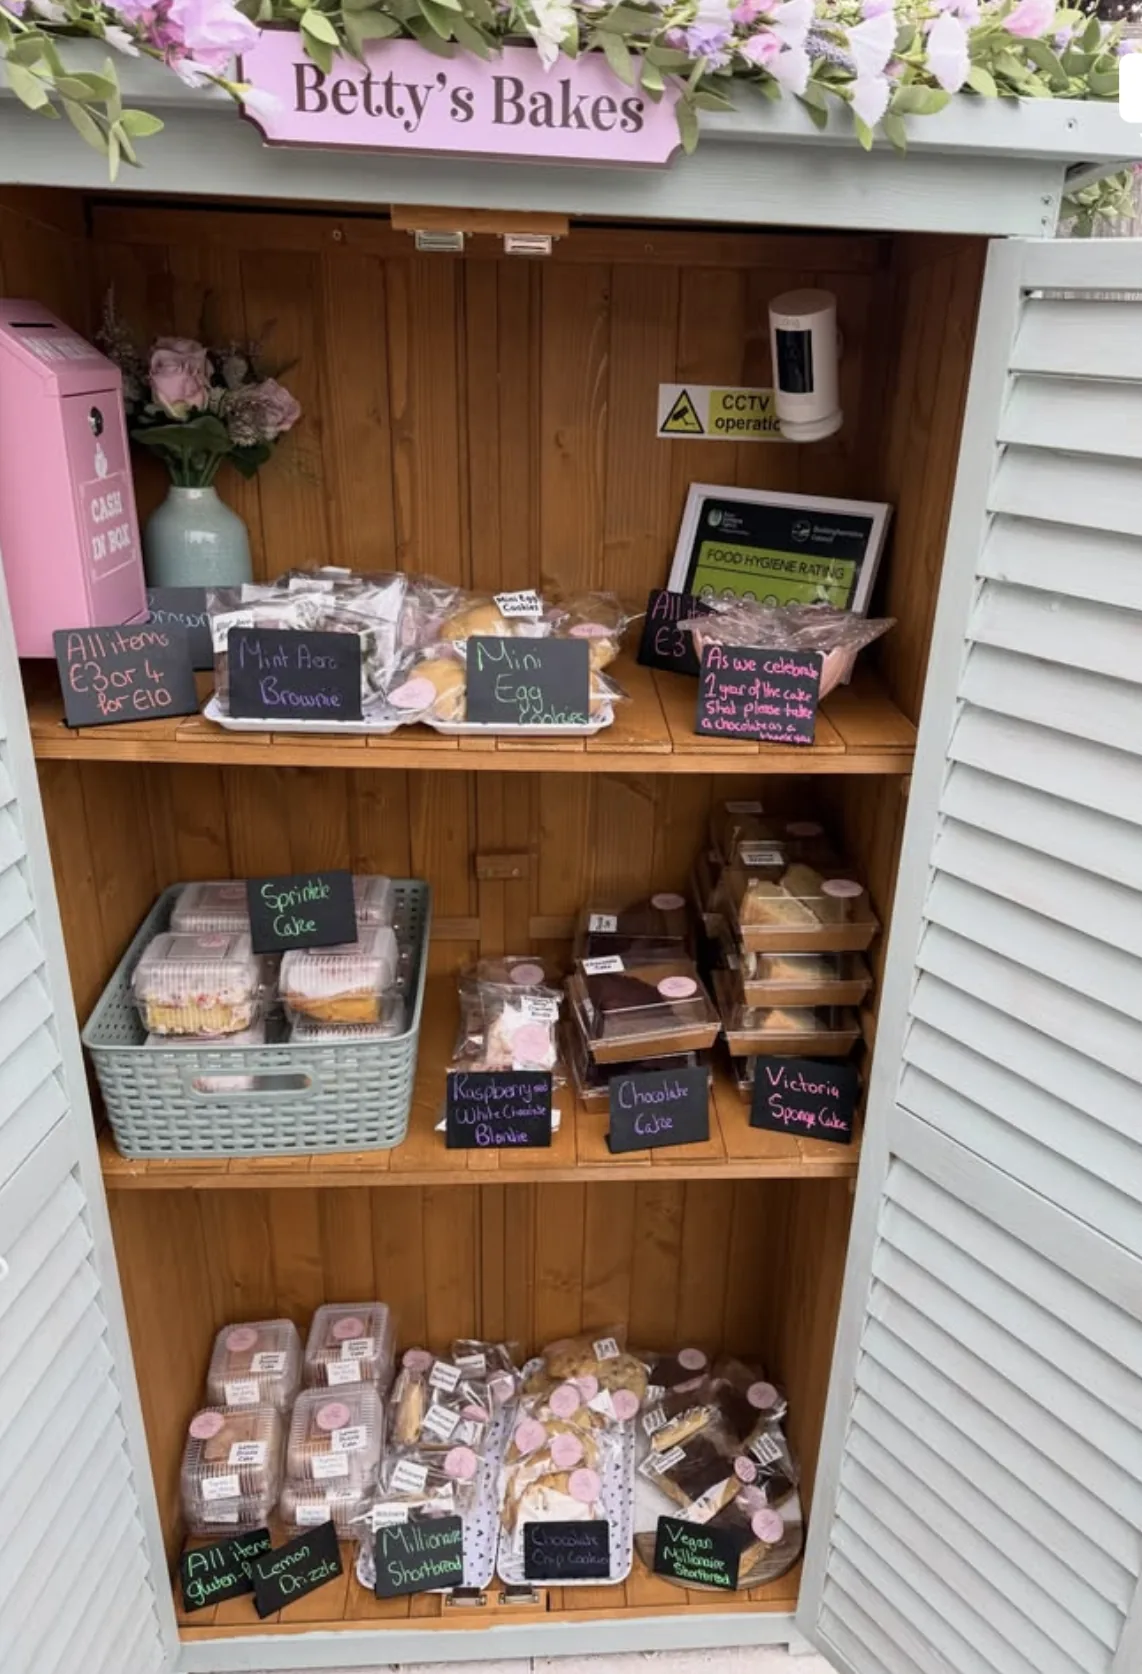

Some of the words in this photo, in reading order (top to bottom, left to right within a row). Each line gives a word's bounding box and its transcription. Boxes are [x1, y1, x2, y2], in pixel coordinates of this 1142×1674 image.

[293, 62, 475, 133] Betty's
[491, 75, 645, 133] Bakes
[722, 393, 771, 411] CCTV
[715, 416, 780, 433] operatio
[90, 491, 123, 522] CASH
[108, 523, 131, 552] BOX
[706, 548, 742, 564] FOOD
[743, 555, 798, 573] HYGIENE
[799, 562, 844, 580] RATING
[651, 591, 682, 620] All
[67, 631, 106, 661] All
[107, 630, 169, 655] items
[238, 636, 289, 670] Mint
[476, 640, 543, 672] Mini
[706, 646, 729, 669] As
[733, 658, 757, 671] we
[110, 667, 137, 687] or
[144, 659, 165, 683] 4
[705, 672, 717, 698] 1
[719, 684, 746, 701] year
[97, 692, 130, 716] for
[259, 675, 343, 707] Brownie
[494, 673, 544, 714] Egg
[260, 877, 331, 913] Sprinkle
[272, 914, 318, 937] Cake
[453, 1073, 533, 1104] Raspberry
[618, 1080, 689, 1110] Chocolate
[765, 1066, 840, 1099] Victoria
[474, 1122, 529, 1146] Blondie
[634, 1112, 674, 1136] Cake
[817, 1106, 850, 1132] Cake
[664, 1523, 713, 1552] Vegan
[187, 1547, 226, 1578] All
[256, 1545, 311, 1580] Lemon
[278, 1559, 339, 1595] Drizzle
[387, 1553, 462, 1587] Shortbread
[186, 1561, 252, 1605] gluten-f
